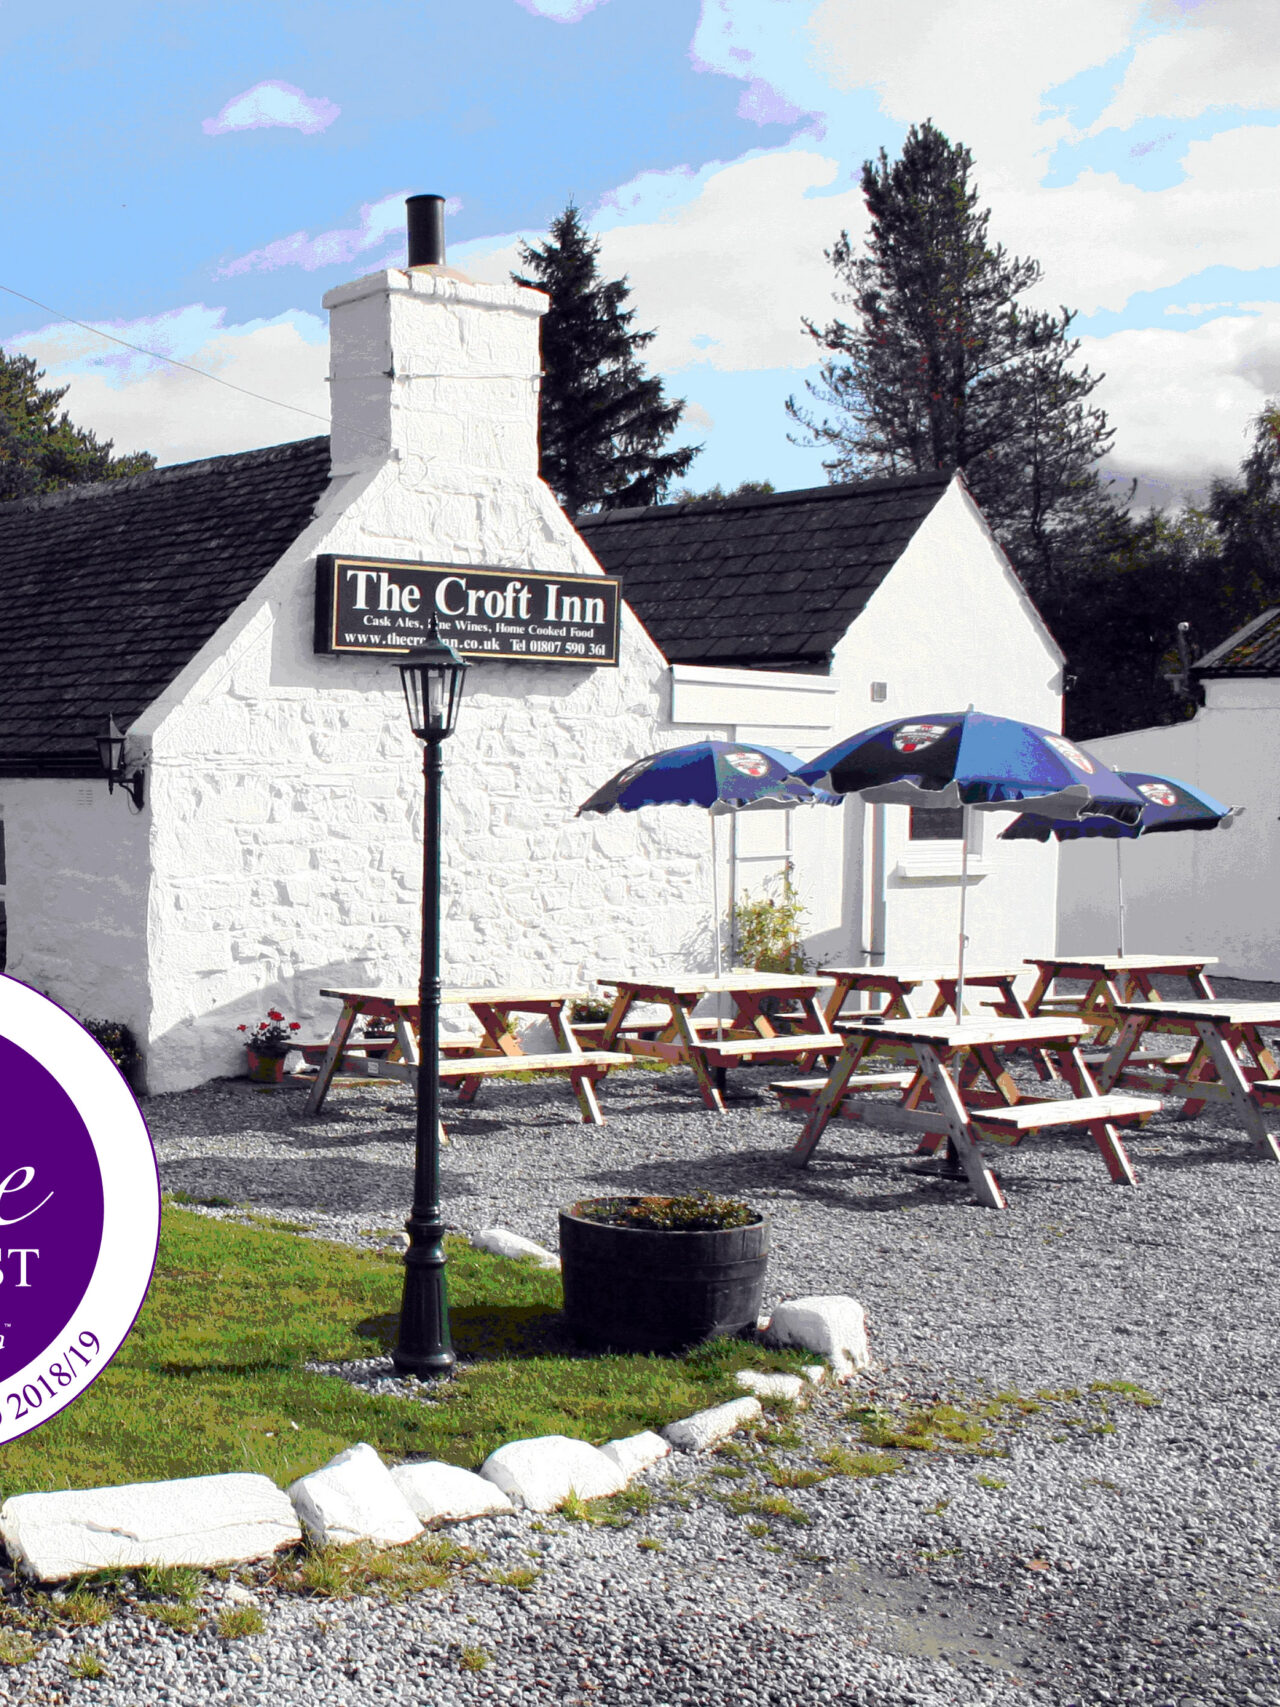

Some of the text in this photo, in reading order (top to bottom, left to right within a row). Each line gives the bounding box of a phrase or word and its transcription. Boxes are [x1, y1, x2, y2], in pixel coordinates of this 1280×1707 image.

[347, 570, 606, 625] The Croft Inn
[363, 615, 594, 638] Cask Ales, ne Wines, Home Cooked Food
[345, 633, 606, 656] www.thecrnn.co.uk Tel 01807 590 361
